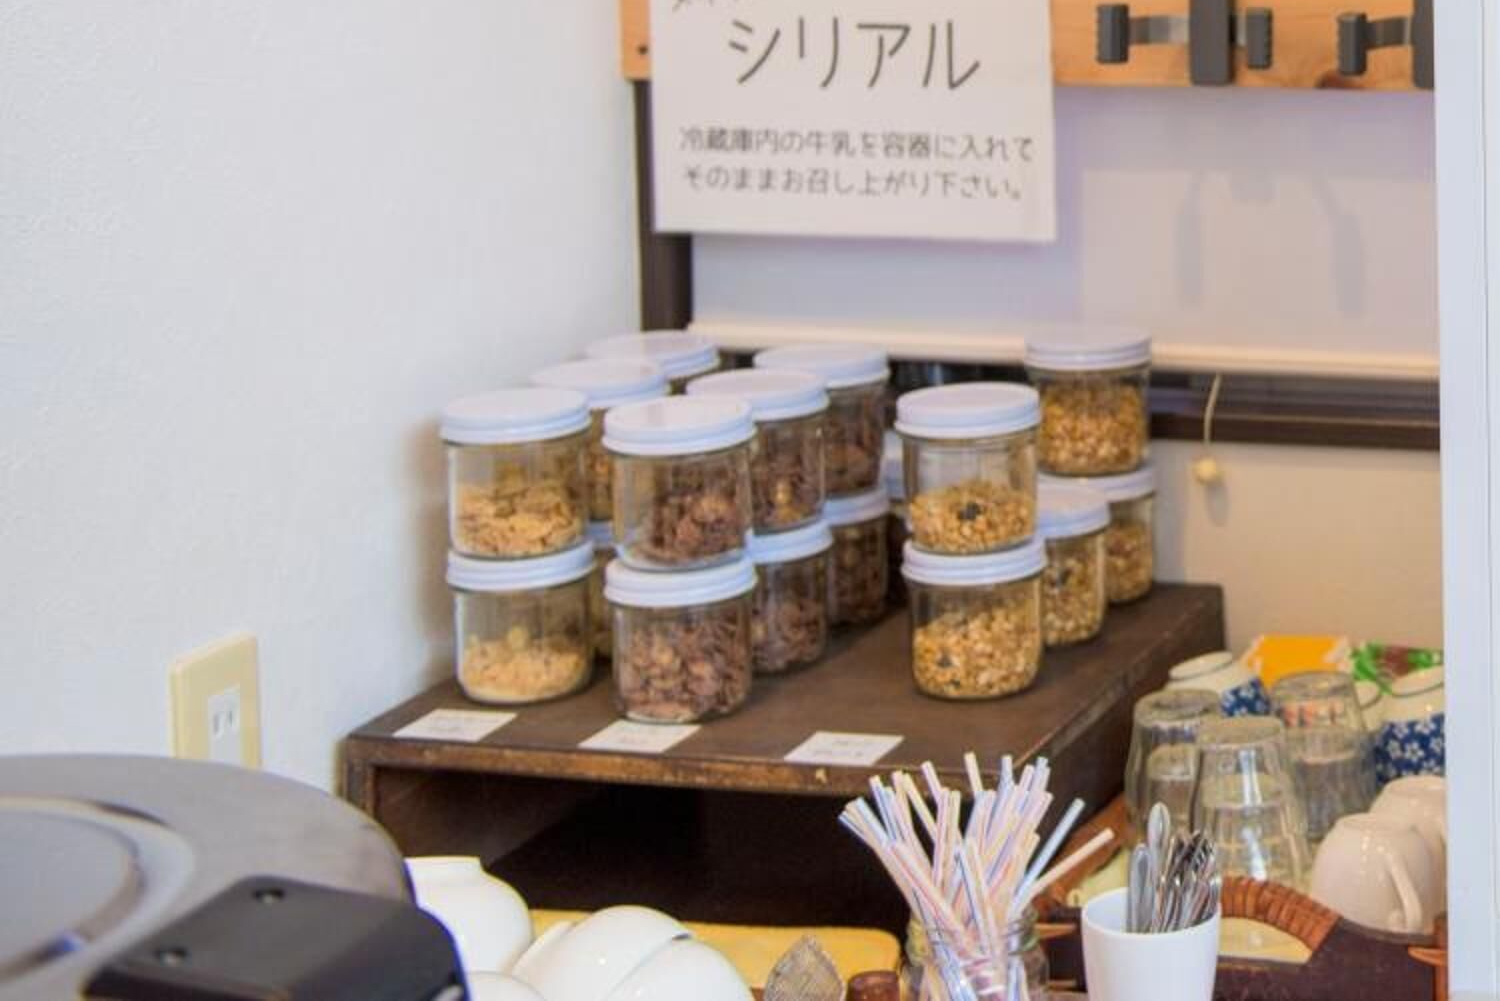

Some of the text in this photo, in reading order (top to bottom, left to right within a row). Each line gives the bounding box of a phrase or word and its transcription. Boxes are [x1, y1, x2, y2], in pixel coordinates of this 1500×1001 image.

[727, 15, 981, 91] シリアル
[678, 125, 1033, 163] 冷蔵庫内の牛乳を容器に入れて
[684, 164, 1022, 200] そのままお召し上がり下さい。
